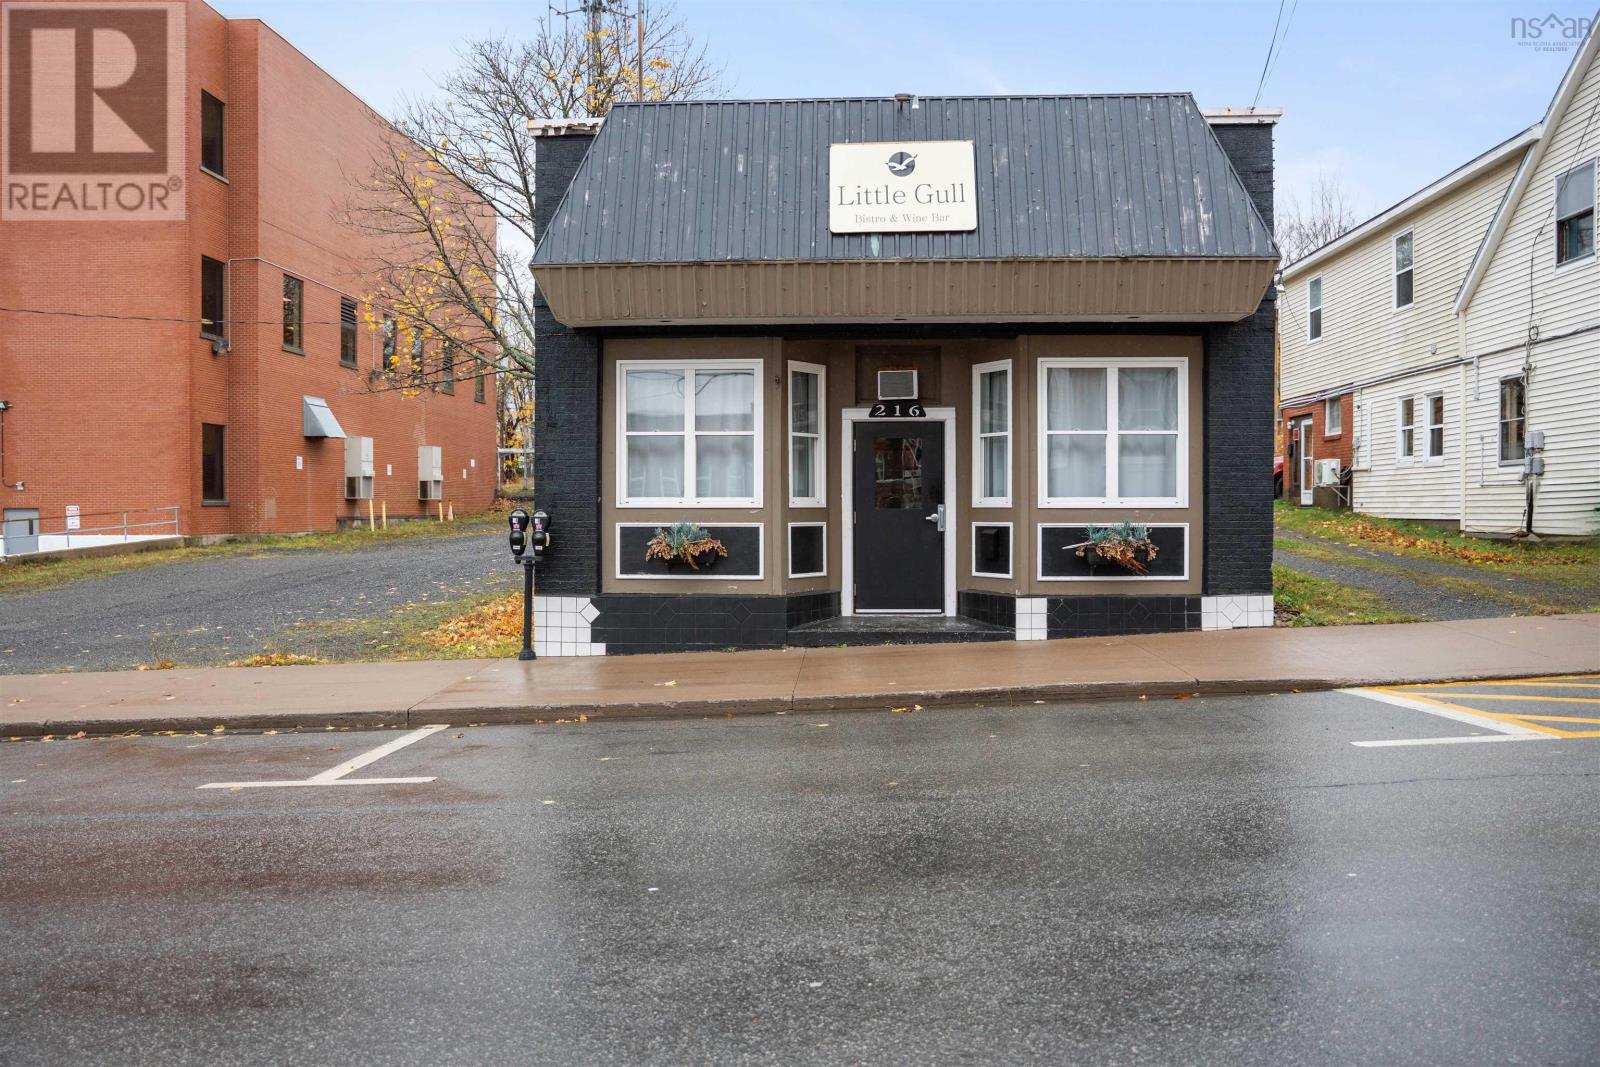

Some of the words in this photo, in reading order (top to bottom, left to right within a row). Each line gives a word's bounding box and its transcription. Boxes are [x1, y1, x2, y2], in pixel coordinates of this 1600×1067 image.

[838, 184, 906, 206] Little
[915, 183, 967, 204] Gull
[855, 214, 886, 223] Bistro
[890, 213, 898, 223] &
[902, 213, 928, 222] Wine
[932, 212, 950, 222] Bar
[875, 405, 920, 417] 216
